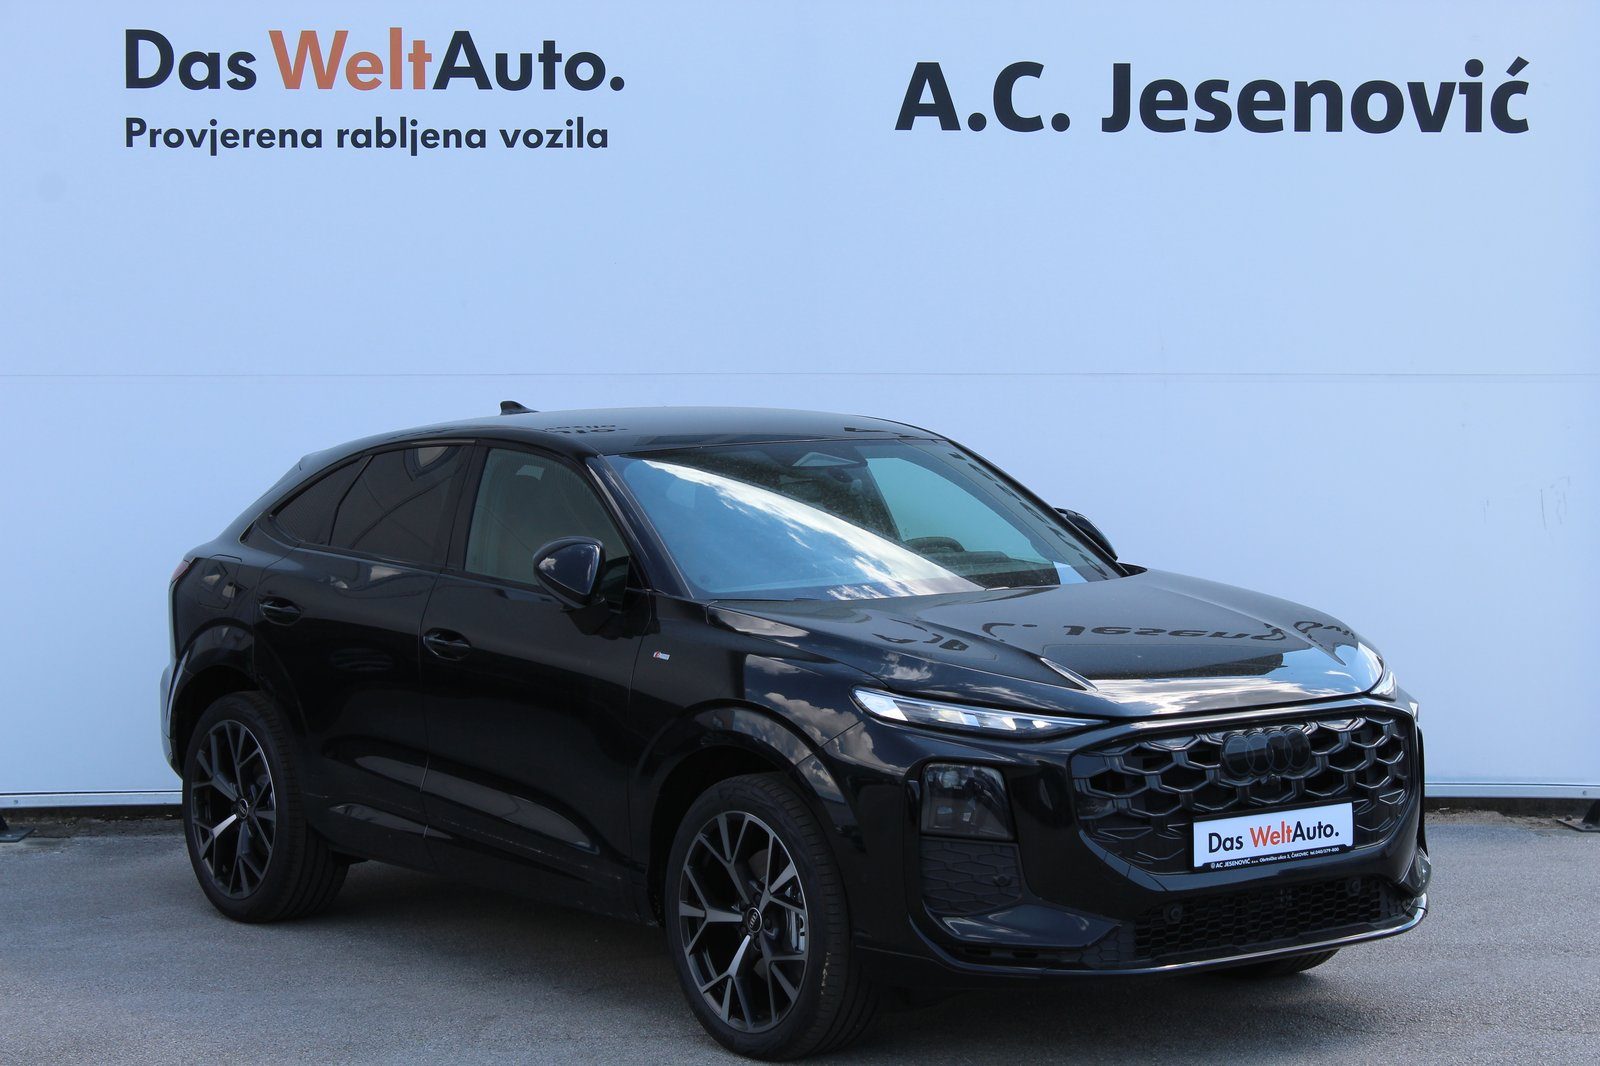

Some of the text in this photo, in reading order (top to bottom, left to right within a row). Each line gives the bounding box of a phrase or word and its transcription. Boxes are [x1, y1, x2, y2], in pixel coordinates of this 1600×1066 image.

[126, 28, 624, 91] Das WeltAuto.
[895, 56, 1530, 133] A.C. Jesenović
[126, 117, 608, 157] Provjerena rabljena vozila
[1208, 820, 1340, 853] Das WeltAuto.
